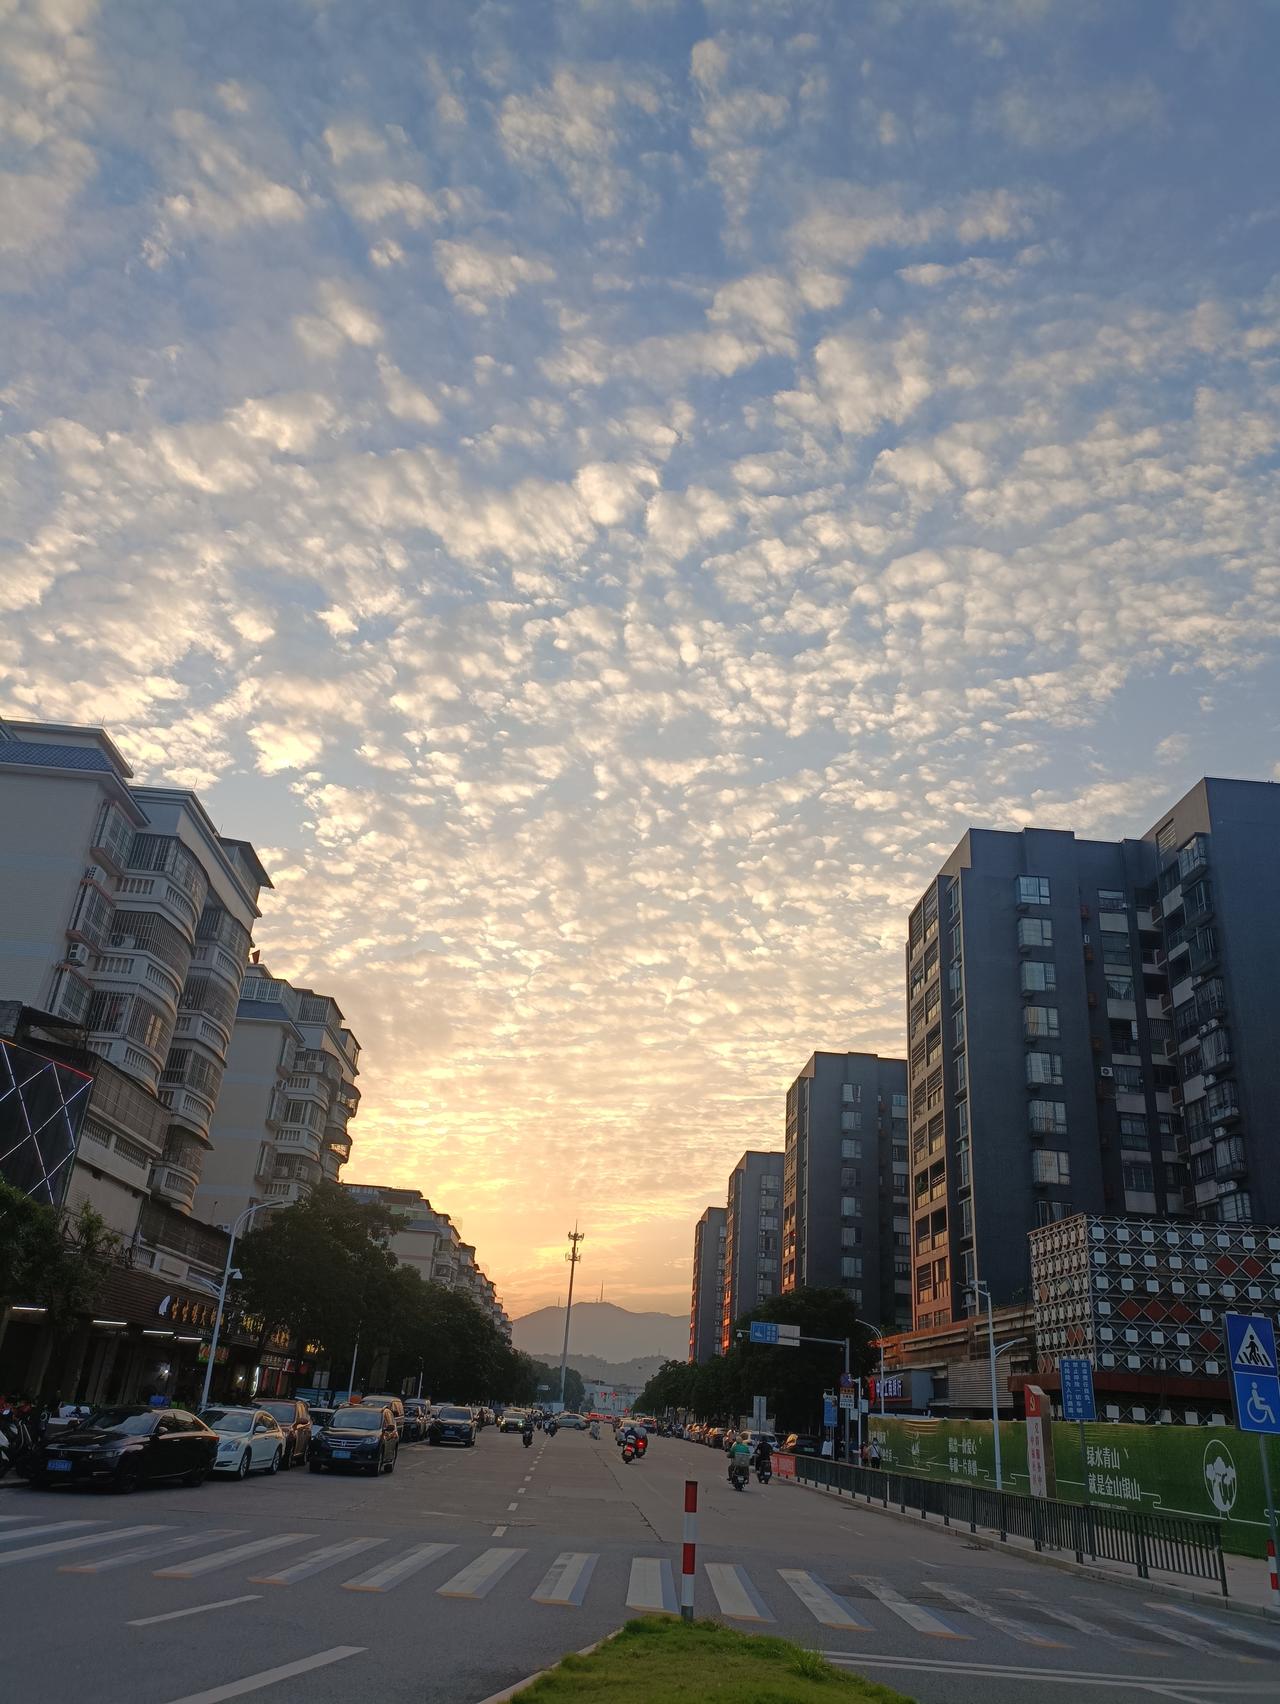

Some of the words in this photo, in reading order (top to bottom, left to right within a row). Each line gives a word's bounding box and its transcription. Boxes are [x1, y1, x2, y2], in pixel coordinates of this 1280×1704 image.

[1086, 1445, 1120, 1470] 绿水青山
[1088, 1472, 1141, 1502] 就是金山银山
